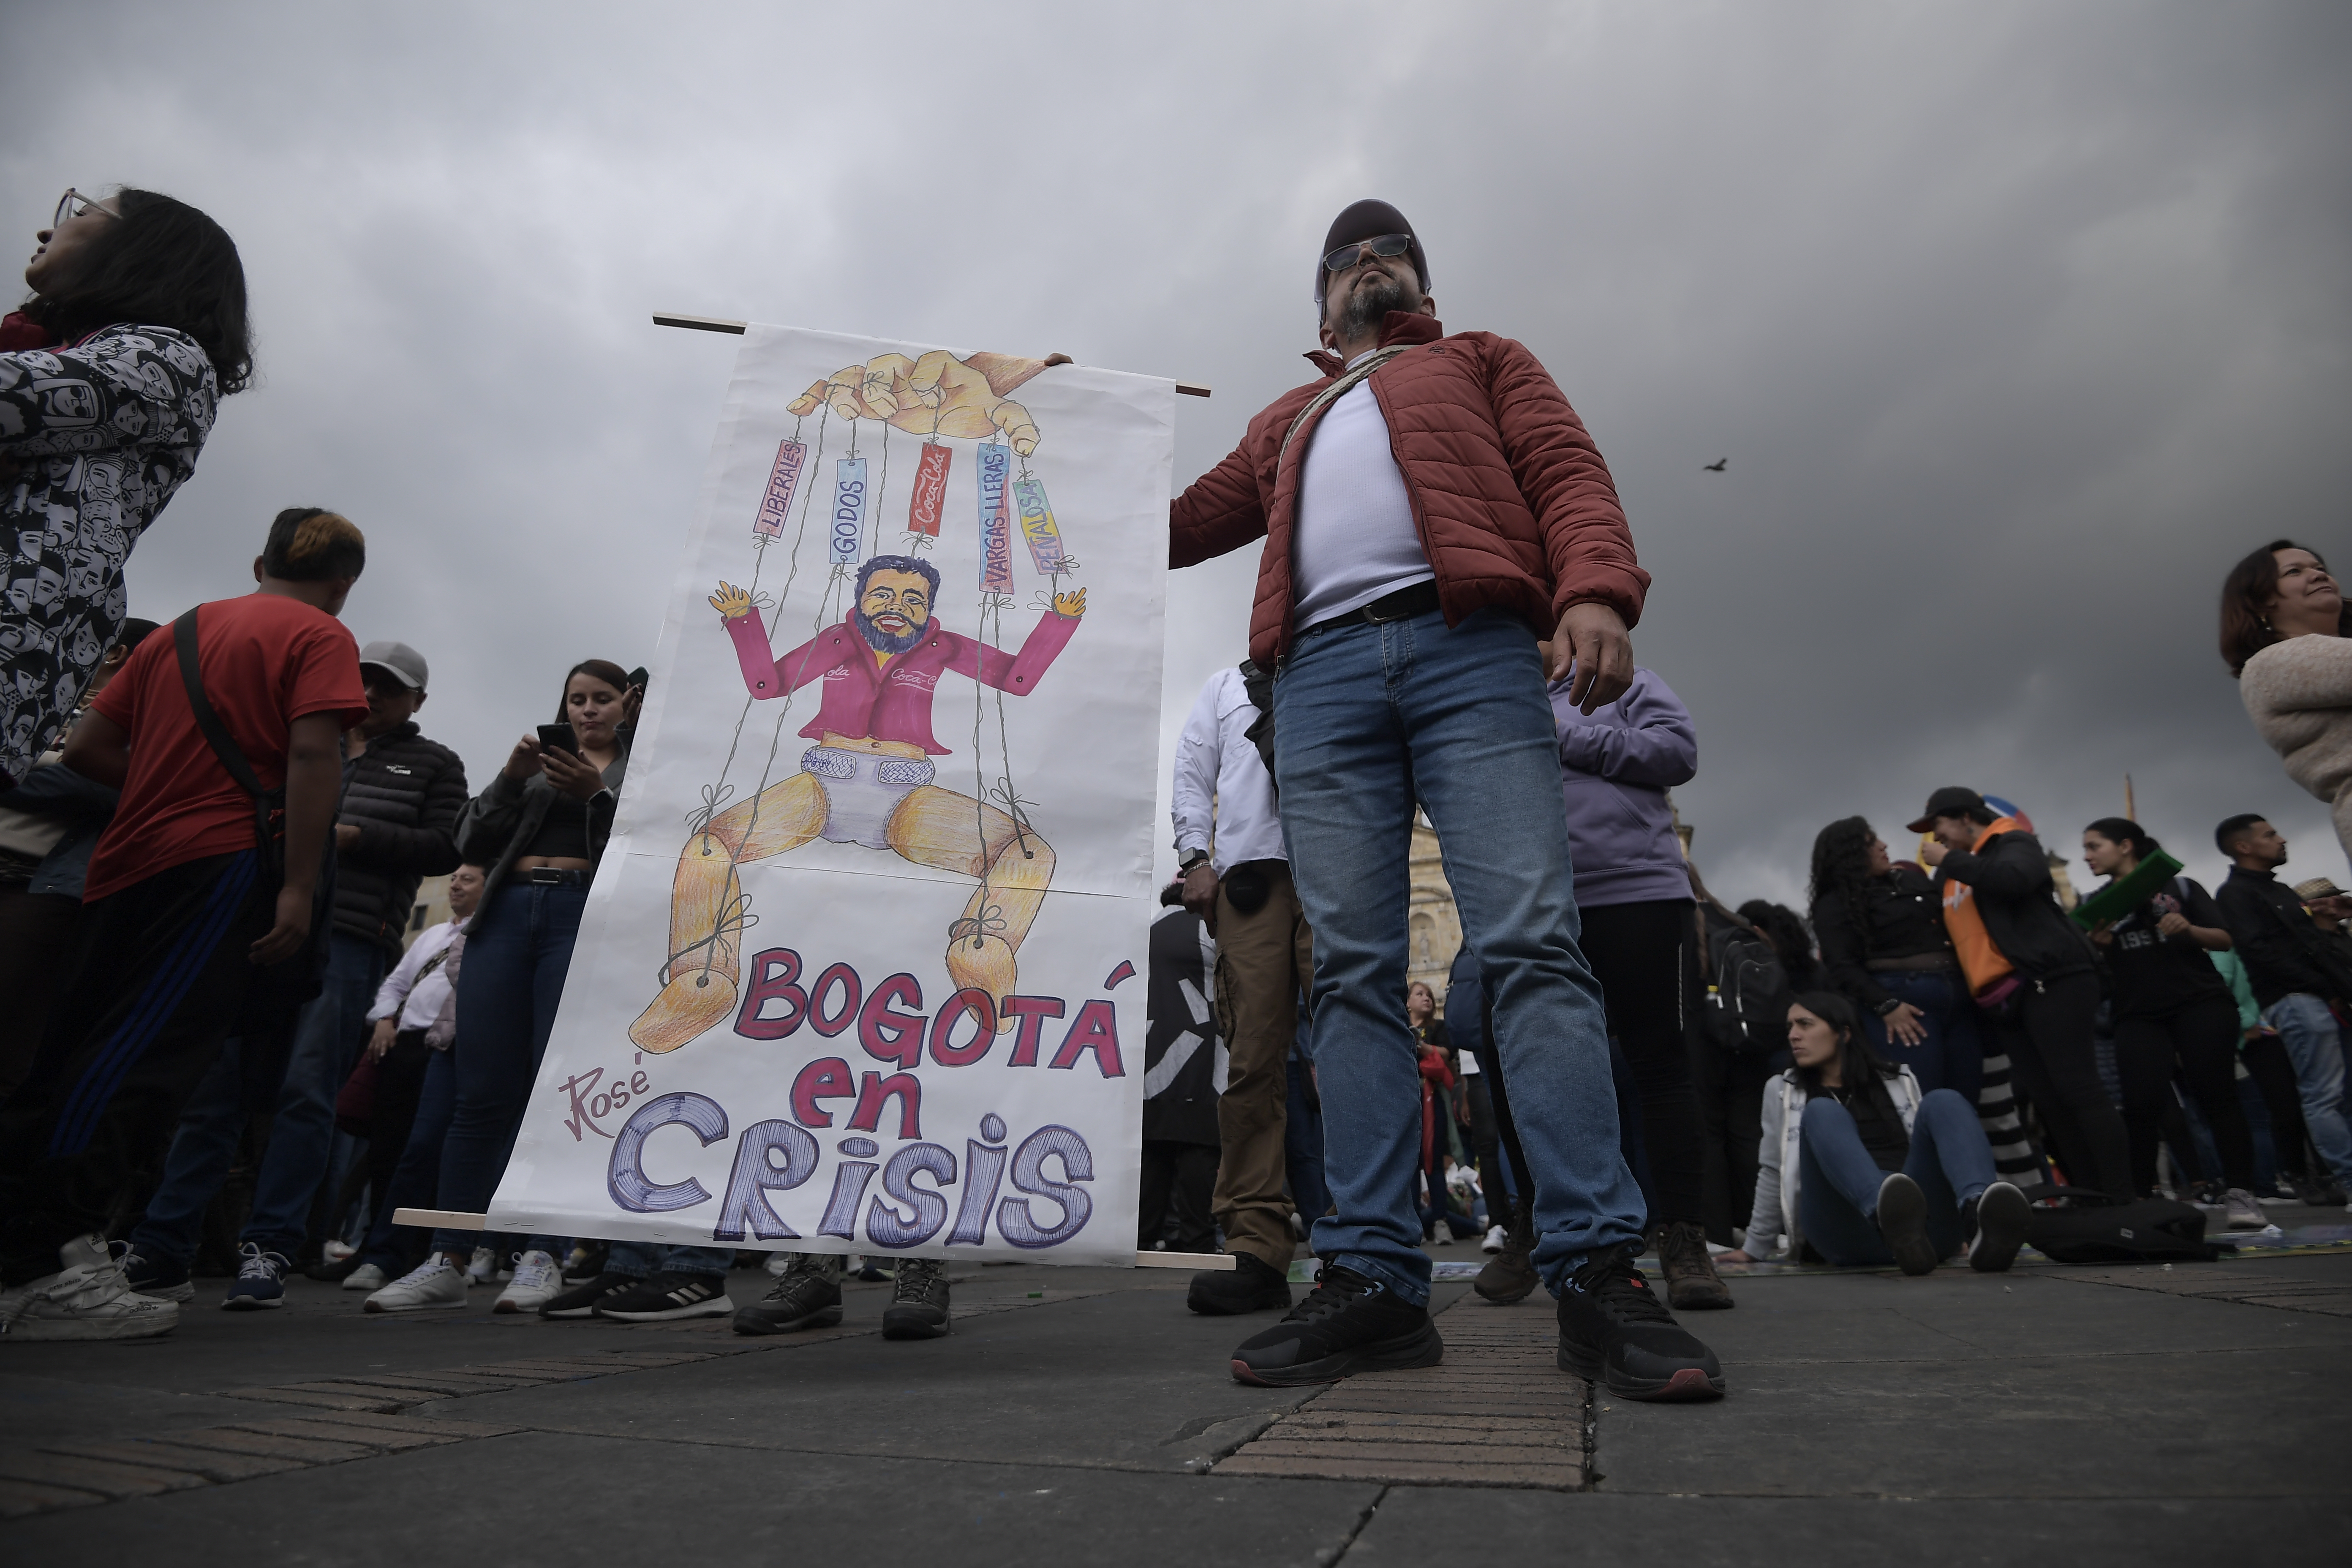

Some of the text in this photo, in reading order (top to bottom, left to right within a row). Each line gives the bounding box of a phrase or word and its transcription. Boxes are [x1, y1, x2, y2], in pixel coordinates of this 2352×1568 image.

[762, 444, 801, 527] LIBERALES
[833, 481, 864, 553] GODOS
[915, 453, 946, 523] Coca-Cola
[983, 453, 1008, 583] VARGAS LLERAS
[1019, 483, 1061, 571] PEÑALOSA
[733, 947, 1136, 1078] BOGOTÁ
[790, 1056, 923, 1140] en
